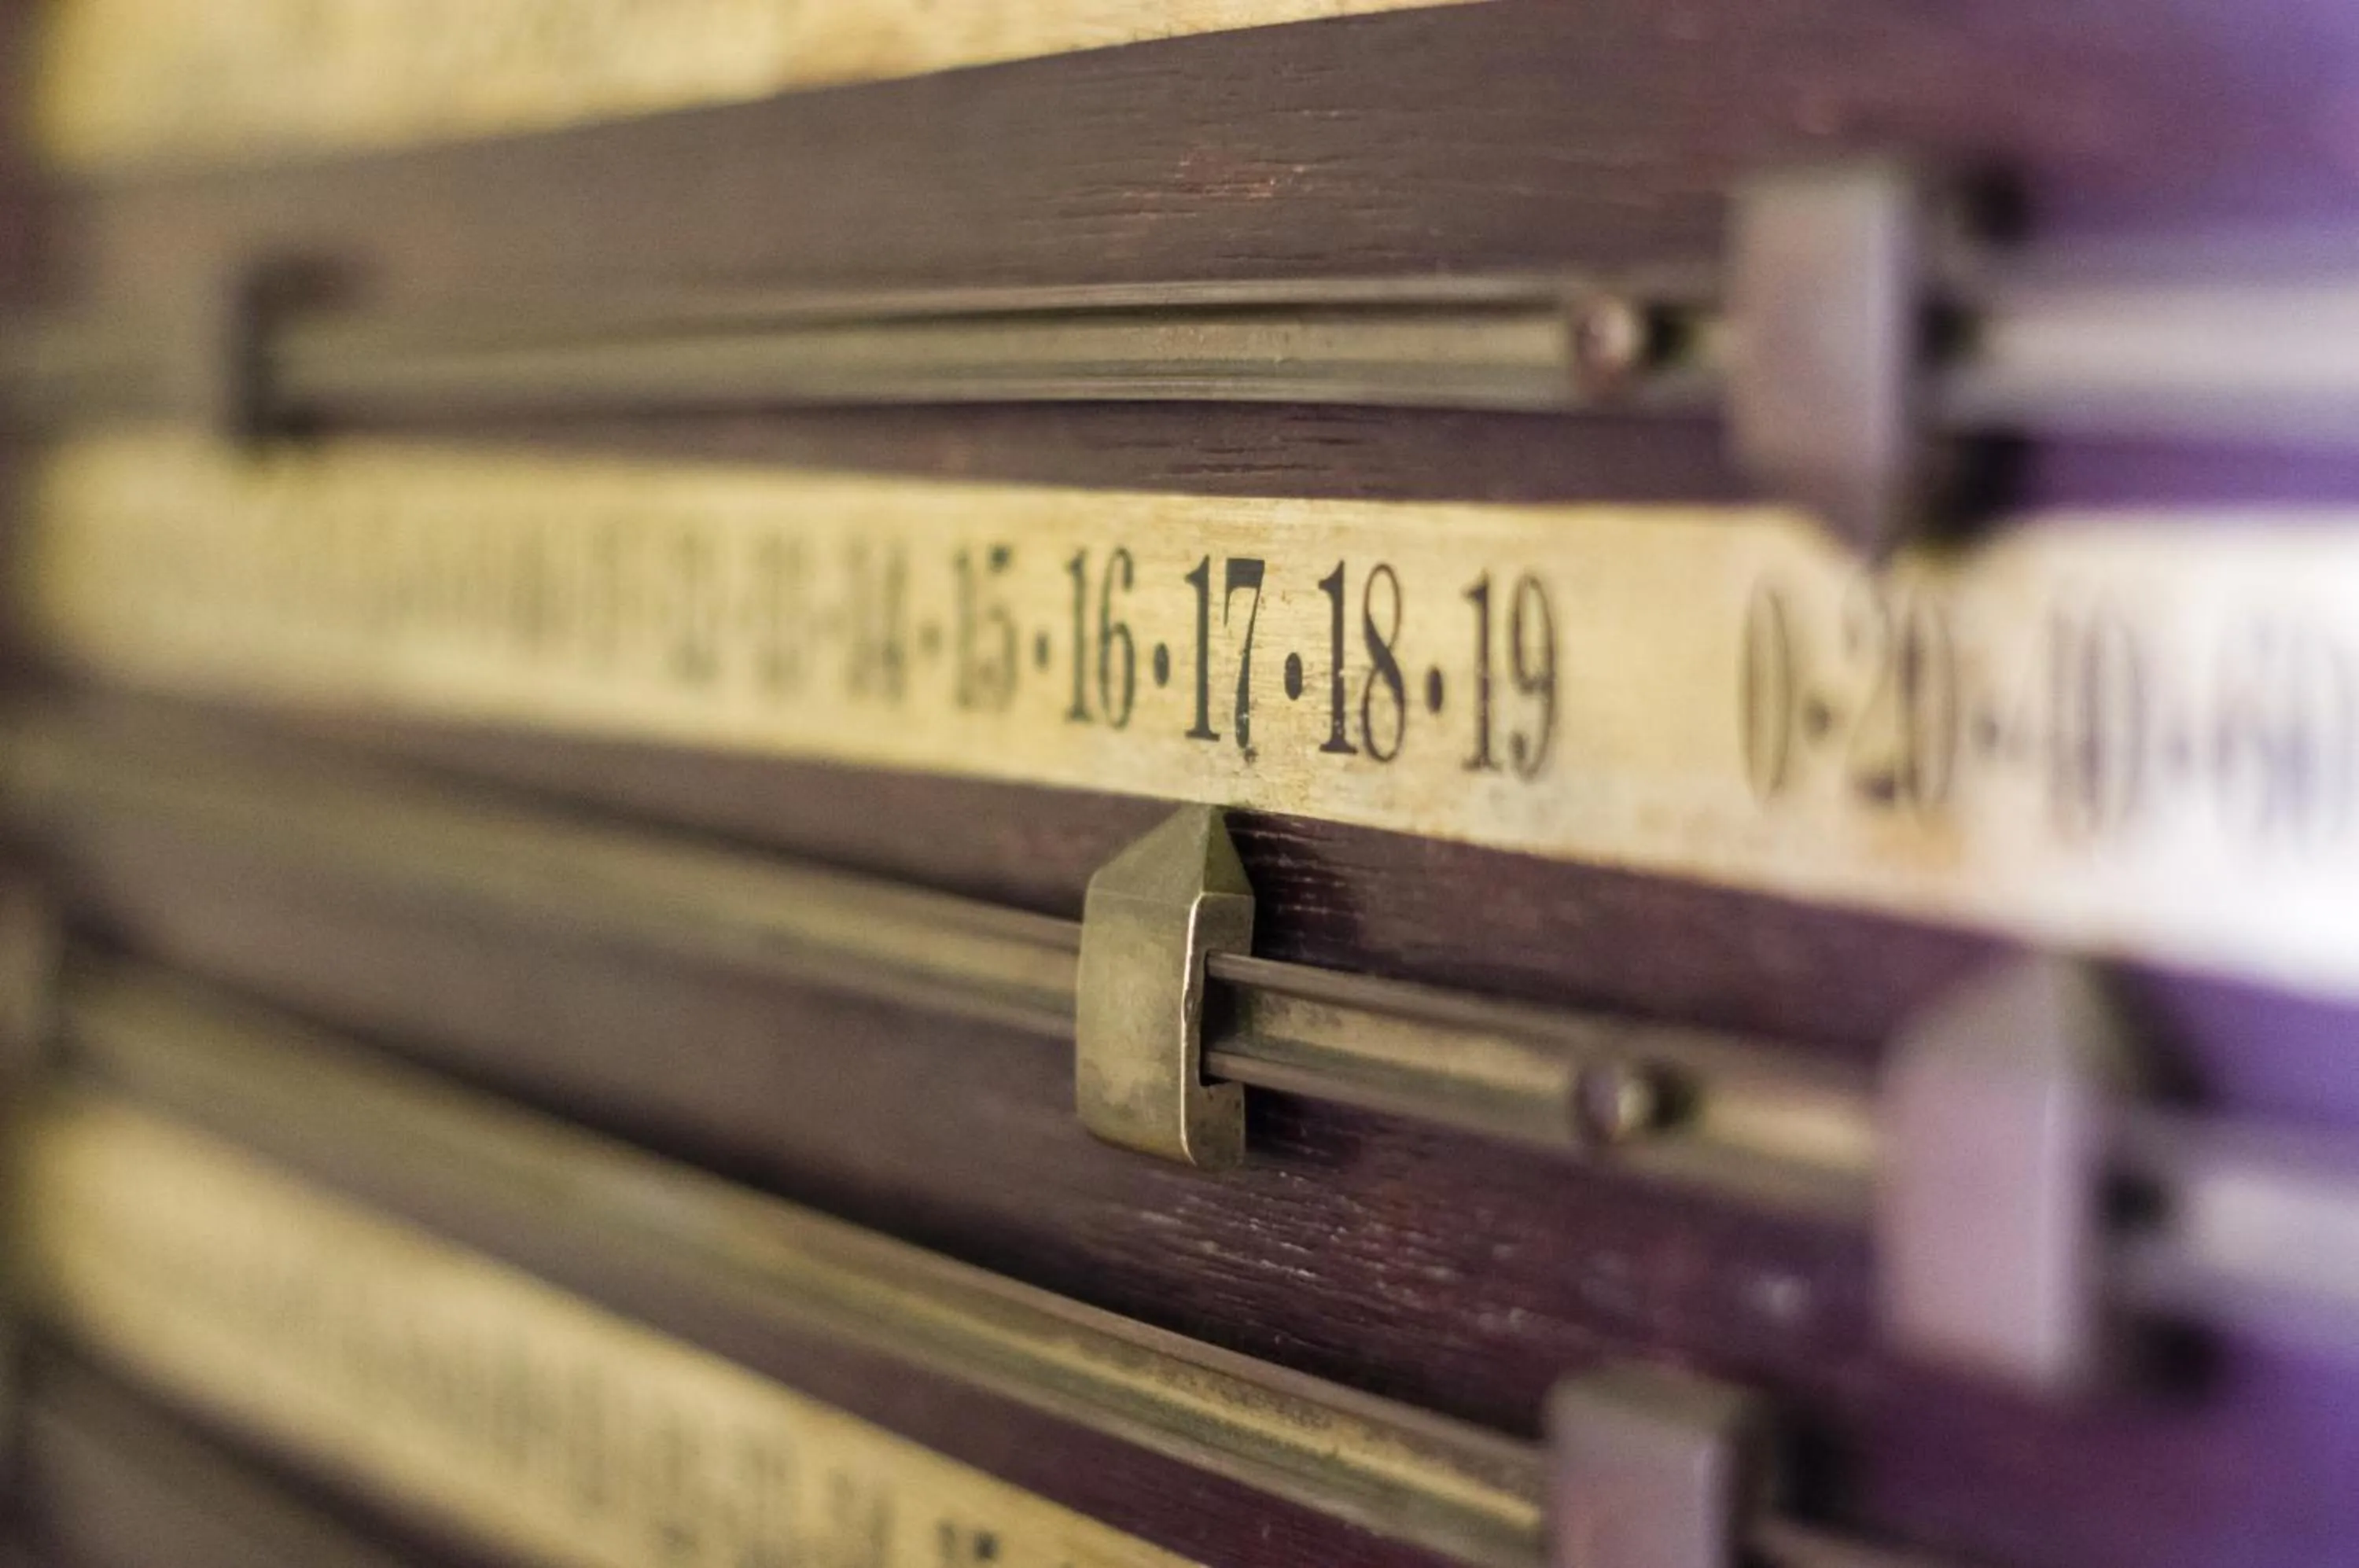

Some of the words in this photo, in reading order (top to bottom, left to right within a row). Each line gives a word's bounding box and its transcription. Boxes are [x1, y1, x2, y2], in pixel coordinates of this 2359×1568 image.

[955, 543, 1019, 712] 15
[1064, 546, 1135, 731] 16
[1183, 554, 1266, 751] 17
[1318, 558, 1407, 763] 18
[1460, 565, 1559, 782] 19
